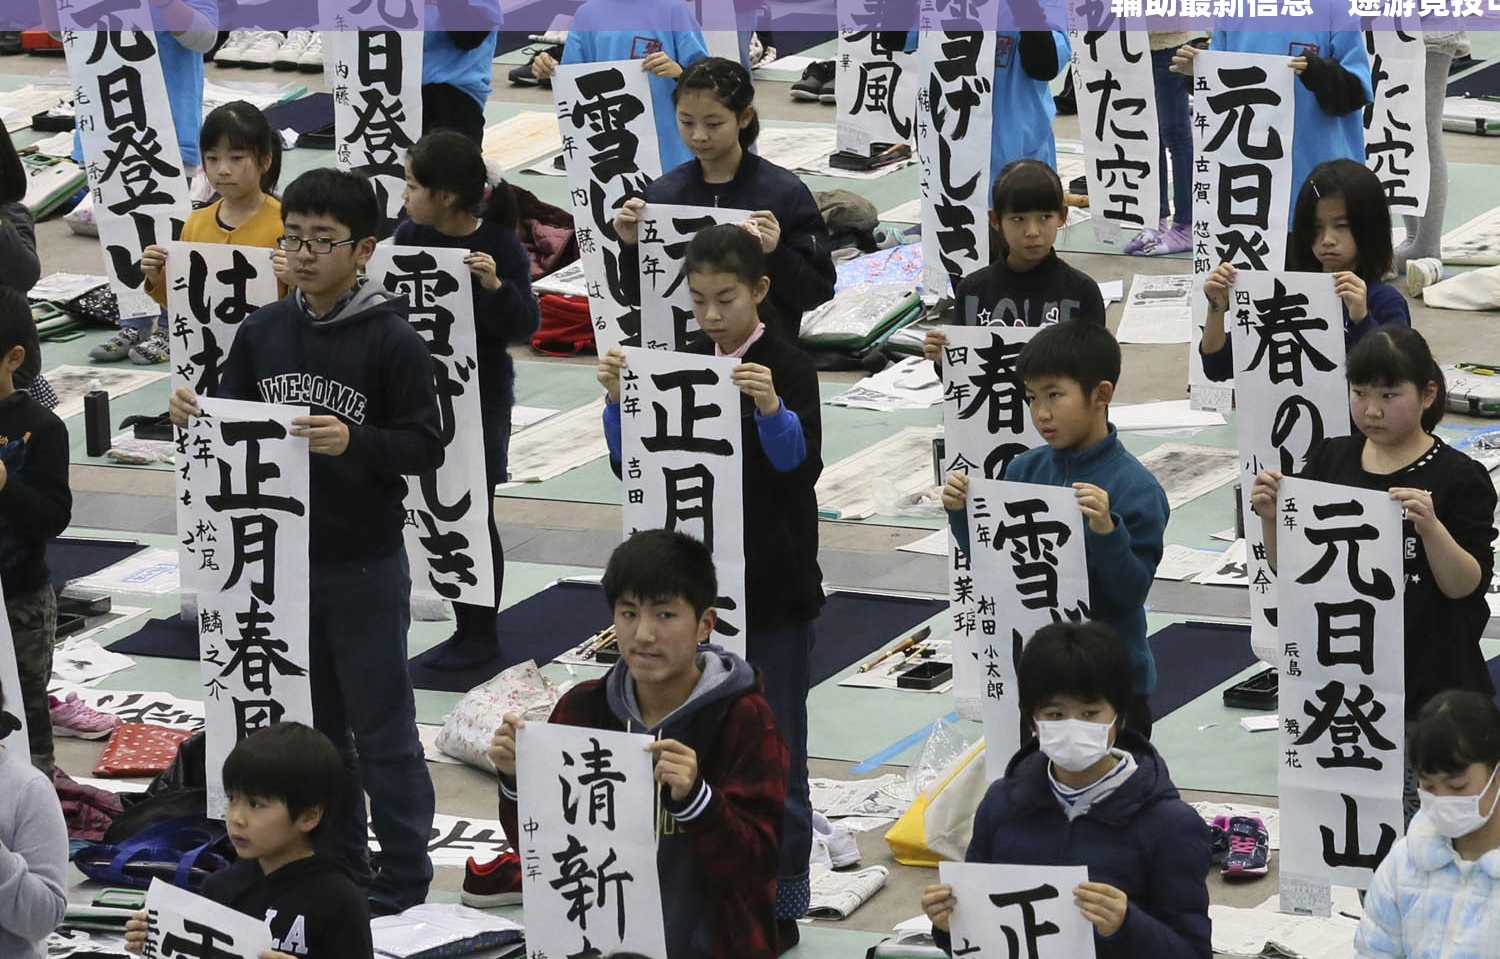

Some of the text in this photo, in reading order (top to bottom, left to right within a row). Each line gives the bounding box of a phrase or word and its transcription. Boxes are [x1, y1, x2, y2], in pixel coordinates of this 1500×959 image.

[75, 86, 97, 133] 毛利
[558, 101, 576, 156] 三年
[1193, 76, 1211, 131] 五年
[1193, 155, 1211, 206] 古賀
[642, 219, 666, 291] 五年
[172, 276, 195, 351] 二年
[1235, 291, 1257, 335] 四年
[944, 345, 974, 419] 四年
[192, 414, 216, 468] 六年
[623, 369, 646, 505] 六年 吉田
[1283, 498, 1299, 532] 五年
[196, 519, 221, 572] 松尾
[972, 498, 1005, 701] 三年 村田 小太郎
[1295, 500, 1398, 872] 元日登山
[523, 817, 544, 883] 中二年
[549, 739, 633, 959] 清新
